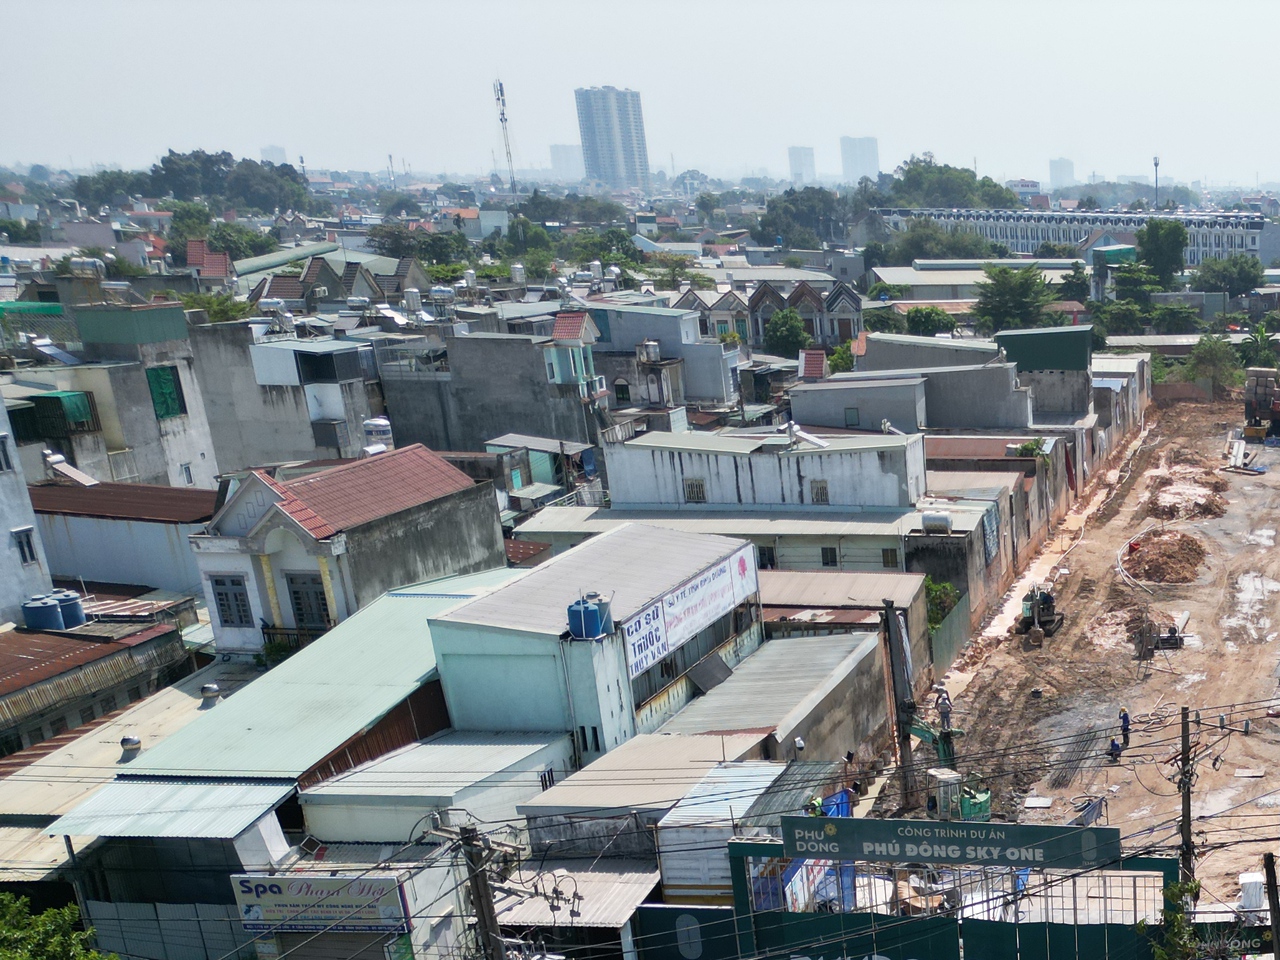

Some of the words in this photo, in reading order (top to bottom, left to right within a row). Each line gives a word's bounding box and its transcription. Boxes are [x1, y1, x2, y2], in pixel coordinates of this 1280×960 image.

[897, 826, 932, 839] CÔNG
[933, 826, 967, 840] TRÌNH
[969, 829, 986, 842] DỰ
[988, 827, 1006, 840] ÁN
[863, 839, 900, 856] PHÚ
[905, 840, 961, 859] ĐÔNG
[966, 845, 1001, 860] SKY
[1005, 847, 1044, 862] ONE
[239, 879, 283, 899] Spa
